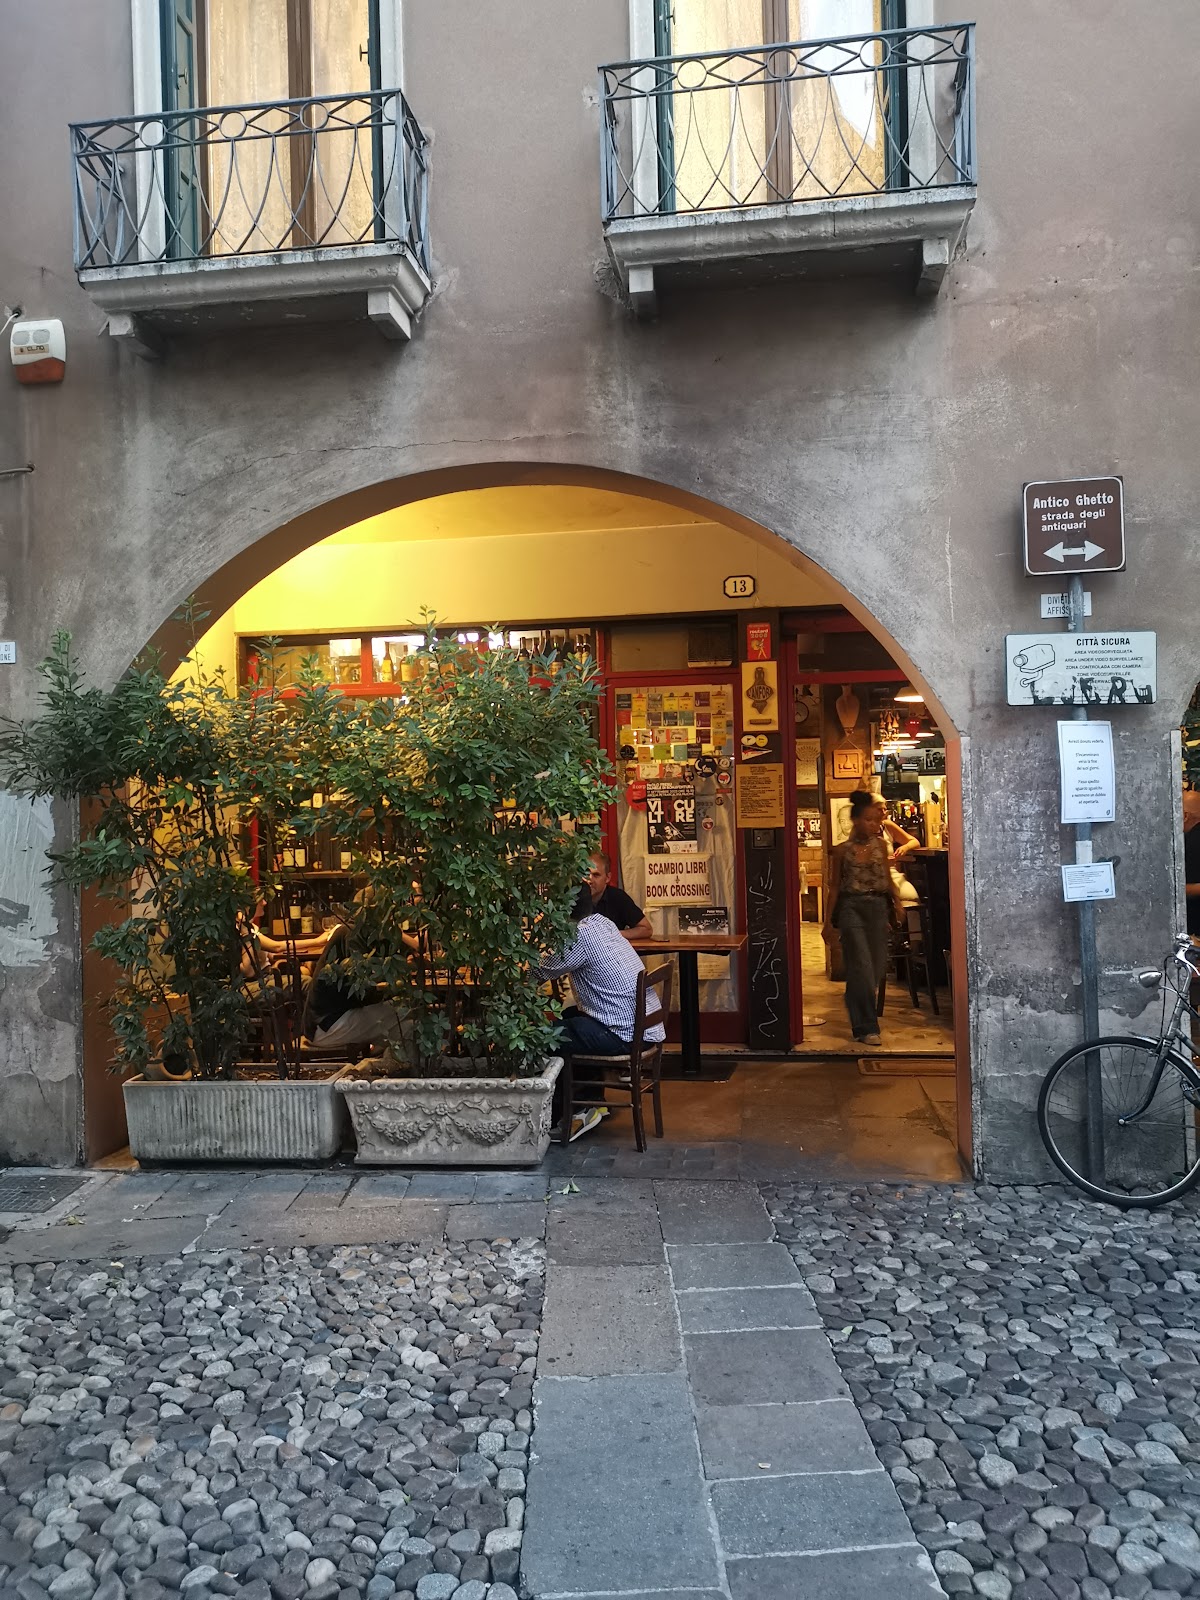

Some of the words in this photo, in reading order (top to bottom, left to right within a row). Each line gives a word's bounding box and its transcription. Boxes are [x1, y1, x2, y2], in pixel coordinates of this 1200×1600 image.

[1033, 496, 1070, 509] Antico
[1075, 492, 1114, 506] Ghetto
[1041, 511, 1075, 521] strada
[1080, 508, 1106, 519] degli
[1041, 520, 1087, 532] antiquari
[733, 580, 747, 593] 13
[1047, 595, 1069, 605] DIVIET
[1076, 636, 1099, 646] CITTÀ
[1101, 637, 1131, 646] SICURA
[648, 862, 684, 875] SCAMBIO
[685, 861, 707, 874] LIBRI
[646, 884, 669, 898] BOOK
[670, 883, 710, 897] CROSSING
